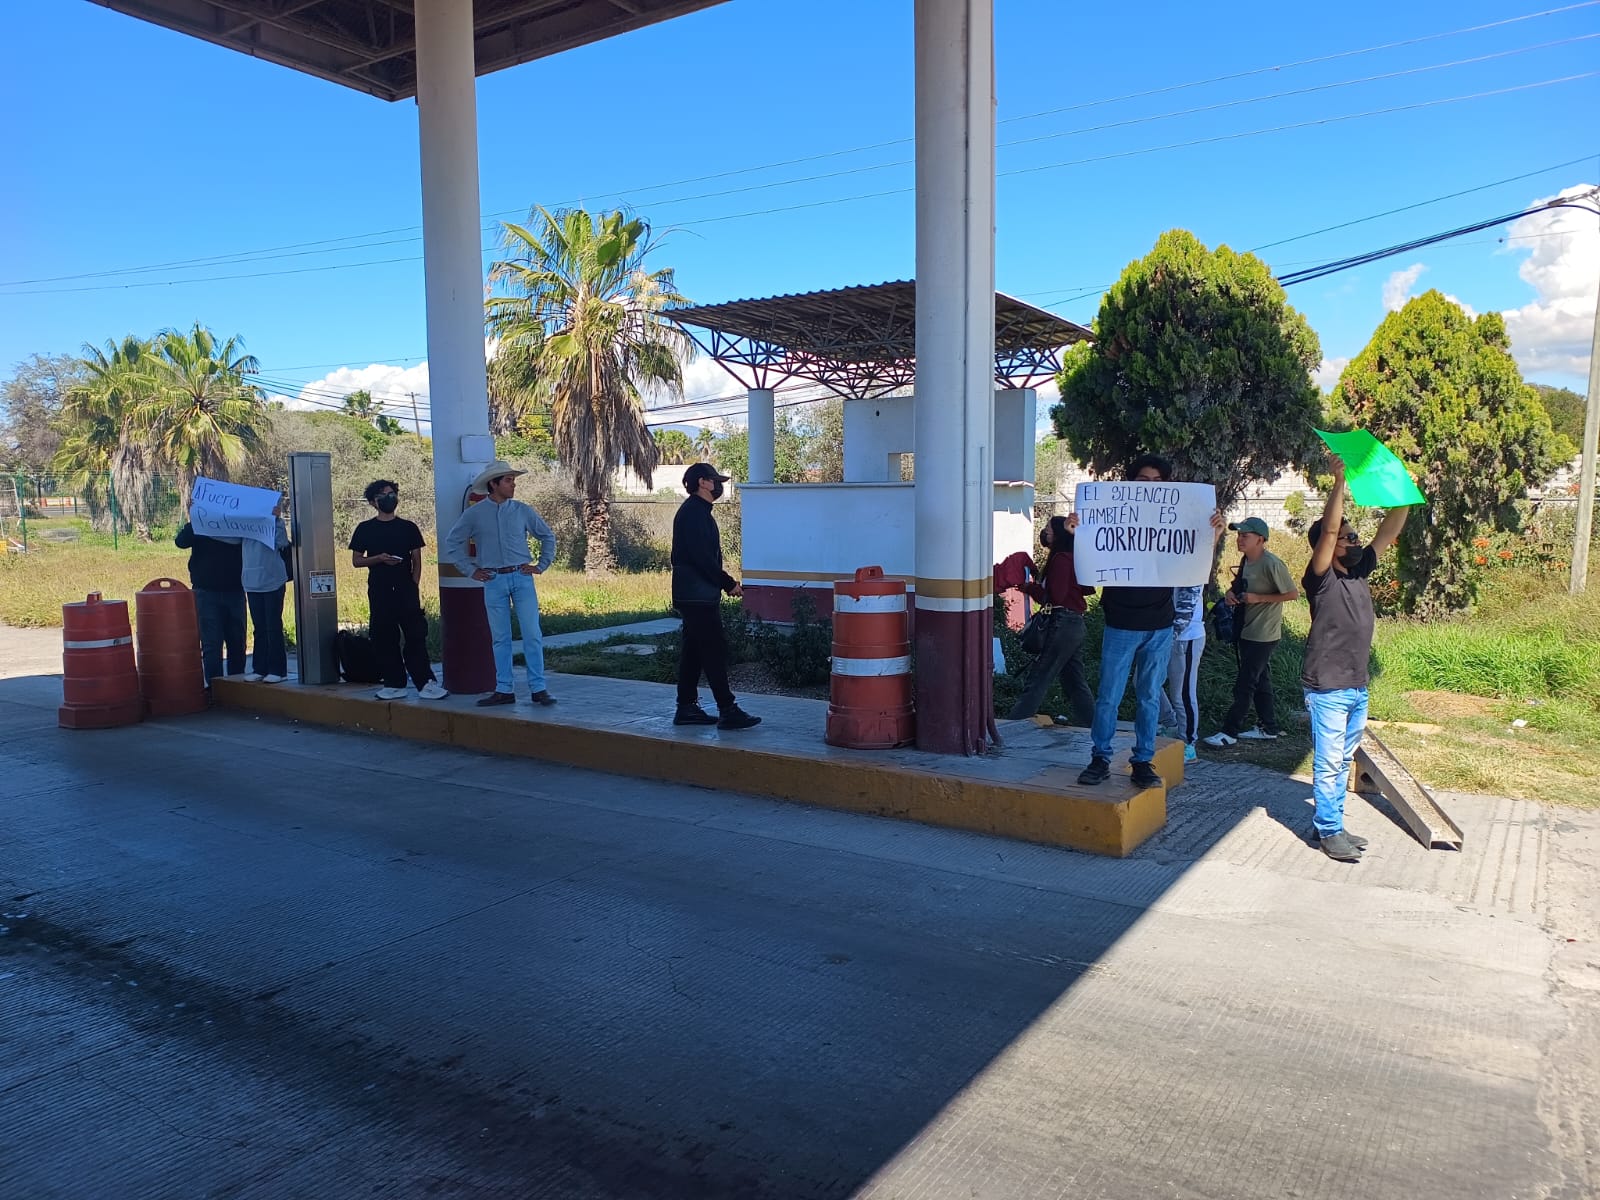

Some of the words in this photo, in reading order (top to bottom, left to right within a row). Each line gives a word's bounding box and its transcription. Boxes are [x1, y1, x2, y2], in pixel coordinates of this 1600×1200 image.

[1084, 485, 1101, 501] EL
[1111, 485, 1180, 506] SILENCIO
[1080, 503, 1139, 525] TAMBIÉN
[1159, 506, 1177, 524] ES
[1095, 526, 1196, 555] CORRUPCION
[1096, 567, 1134, 583] ITT
